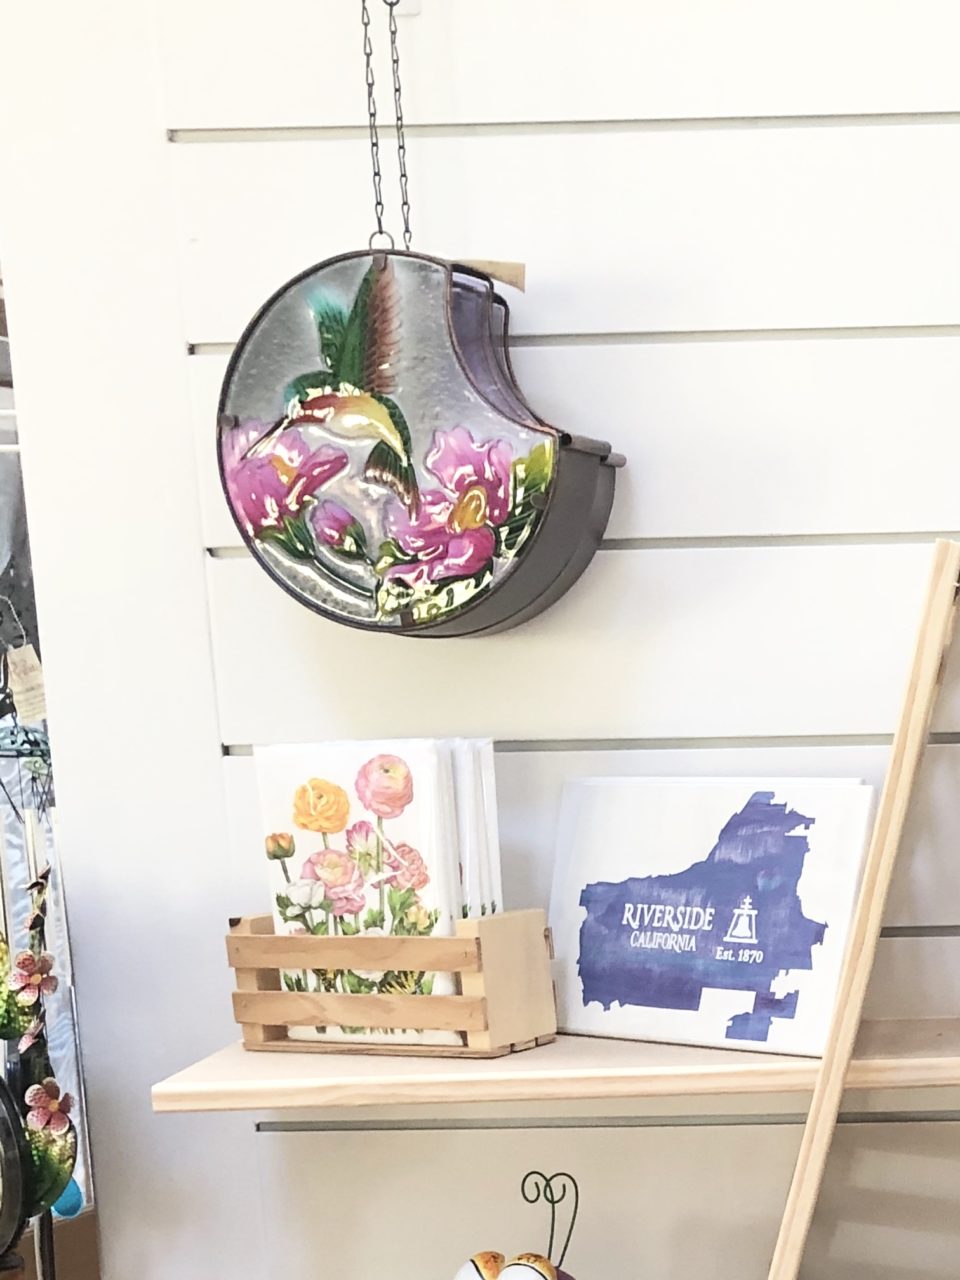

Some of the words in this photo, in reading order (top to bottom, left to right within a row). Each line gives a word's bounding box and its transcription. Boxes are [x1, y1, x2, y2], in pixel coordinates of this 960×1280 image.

[622, 903, 715, 932] RIVERSIDE
[630, 931, 696, 953] CALIFORNIA
[715, 946, 735, 961] Est.
[737, 949, 764, 963] 1870
